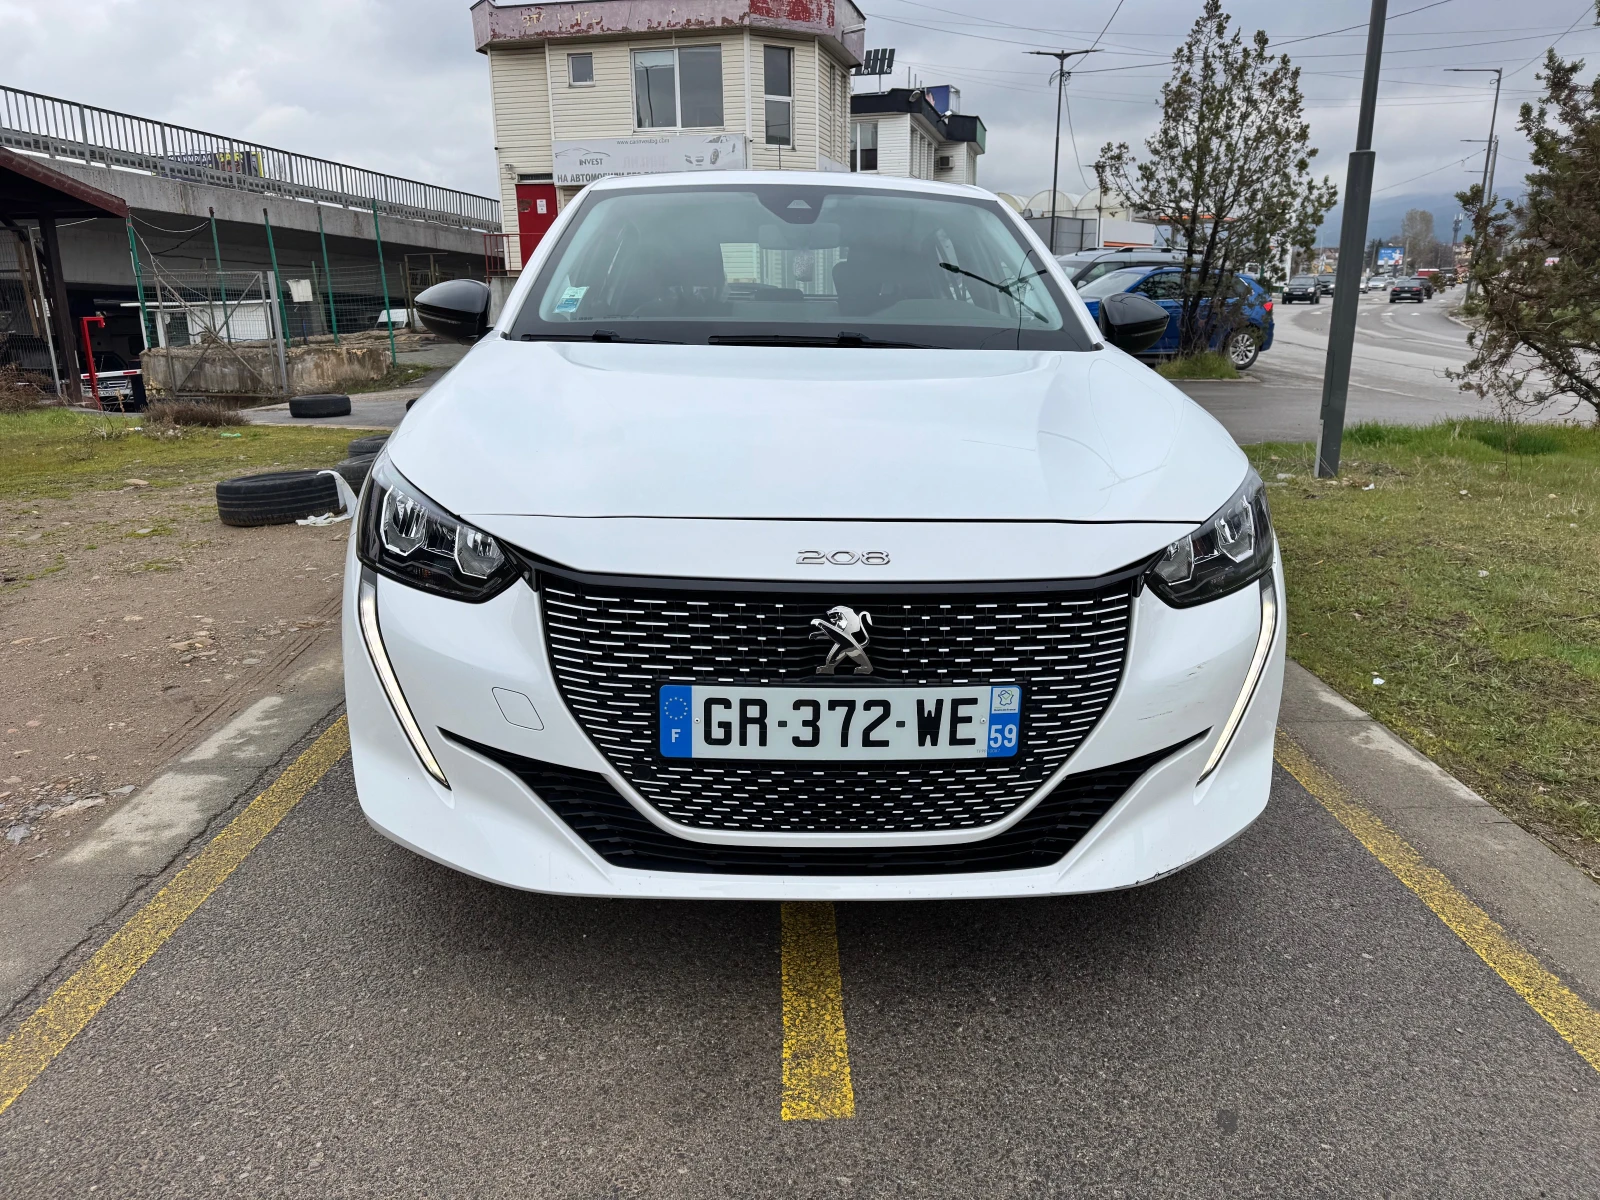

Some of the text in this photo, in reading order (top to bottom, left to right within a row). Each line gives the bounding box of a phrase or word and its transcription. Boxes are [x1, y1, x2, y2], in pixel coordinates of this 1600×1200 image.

[579, 158, 603, 166] INVEST
[557, 174, 569, 183] НА
[570, 172, 625, 183] АВТОМО
[796, 549, 891, 565] 208
[703, 697, 979, 748] GR-372-WE
[671, 729, 681, 743] F
[989, 723, 1017, 748] 59
